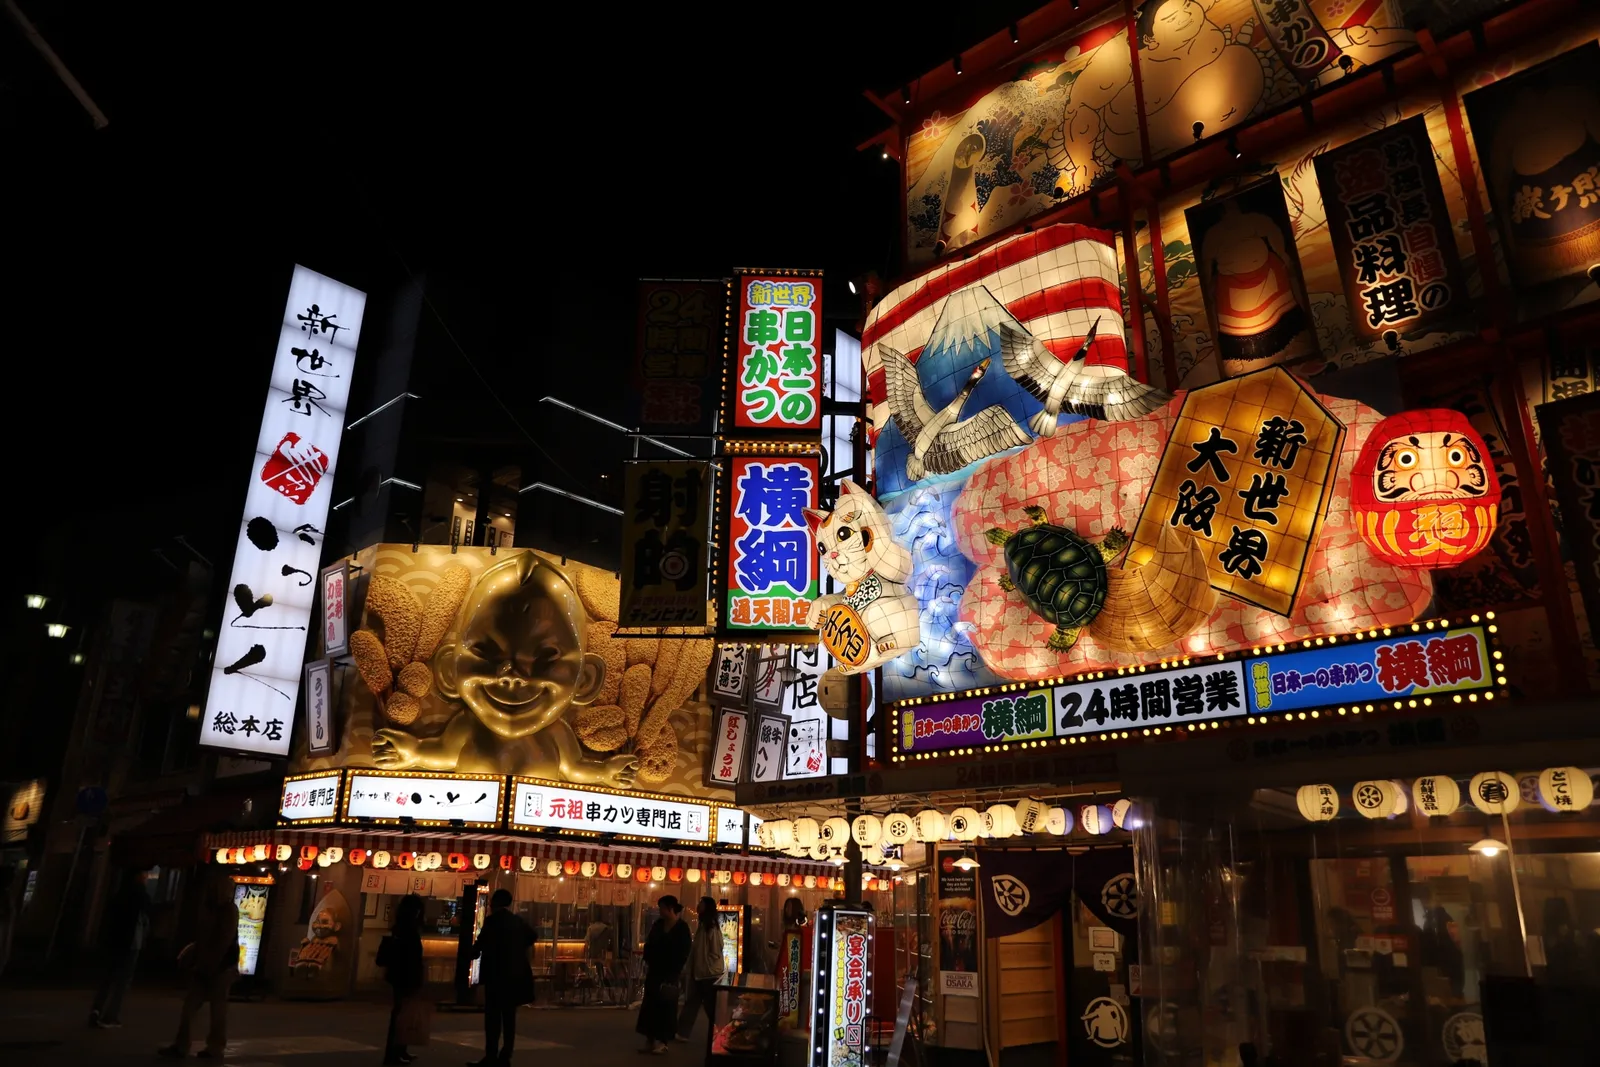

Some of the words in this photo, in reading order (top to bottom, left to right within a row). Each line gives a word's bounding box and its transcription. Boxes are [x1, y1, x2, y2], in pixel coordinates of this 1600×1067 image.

[750, 283, 814, 307] 新世界
[282, 304, 350, 417] 新世界
[745, 309, 778, 420] 串かつ
[781, 310, 813, 421] 日本一の
[1170, 427, 1238, 537] 大阪
[1218, 416, 1308, 579] 新世界
[738, 466, 808, 592] 横綱
[732, 599, 811, 624] 通天閣店
[1272, 663, 1374, 695] 日本一の串かつ
[1375, 633, 1484, 693] 横綱
[915, 714, 980, 738] 日本一の串かつ
[982, 695, 1048, 739] 横綱
[1060, 670, 1240, 730] 24時間営業
[212, 711, 283, 742] 総本店
[720, 715, 740, 777] 紅しょうが
[285, 787, 334, 808] 串カツ専門店
[549, 798, 682, 829] 元祖串カツ専門店
[1420, 778, 1438, 811] 新鮮逸品
[1552, 771, 1573, 806] どて焼
[946, 979, 973, 987] OSAKA
